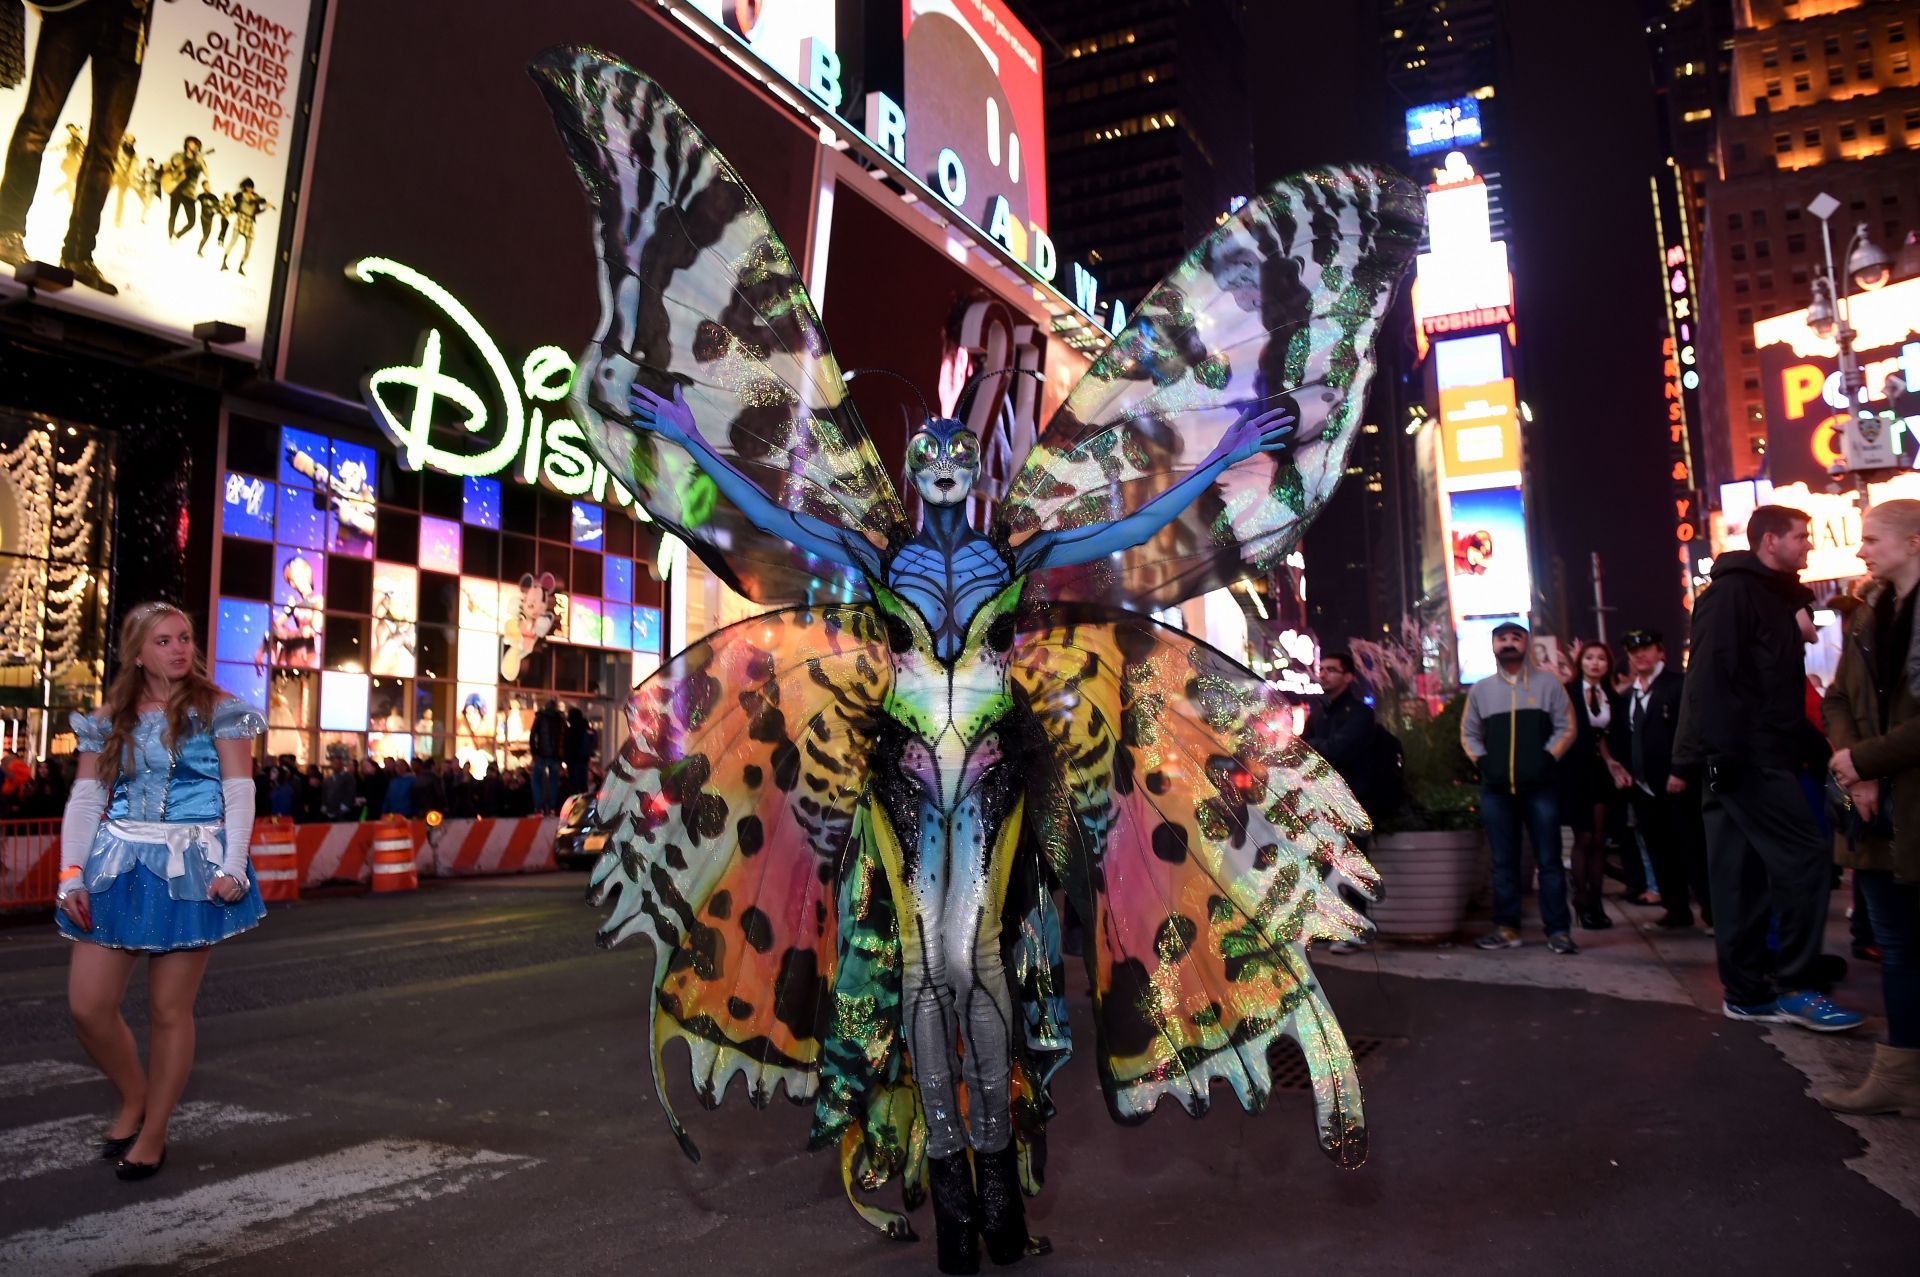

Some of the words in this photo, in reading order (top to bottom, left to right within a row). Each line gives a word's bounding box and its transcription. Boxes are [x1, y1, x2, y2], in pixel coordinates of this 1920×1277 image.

[179, 39, 285, 100] ACADEMY
[207, 31, 288, 84] OLIVIER
[233, 22, 290, 62] TONY
[184, 79, 279, 138] WINNING
[212, 114, 277, 157] MUSIC
[800, 37, 1127, 338] BROADWA
[1423, 305, 1512, 334] TOSHIBA
[344, 256, 674, 582] Disn
[1662, 337, 1684, 443] ERNST
